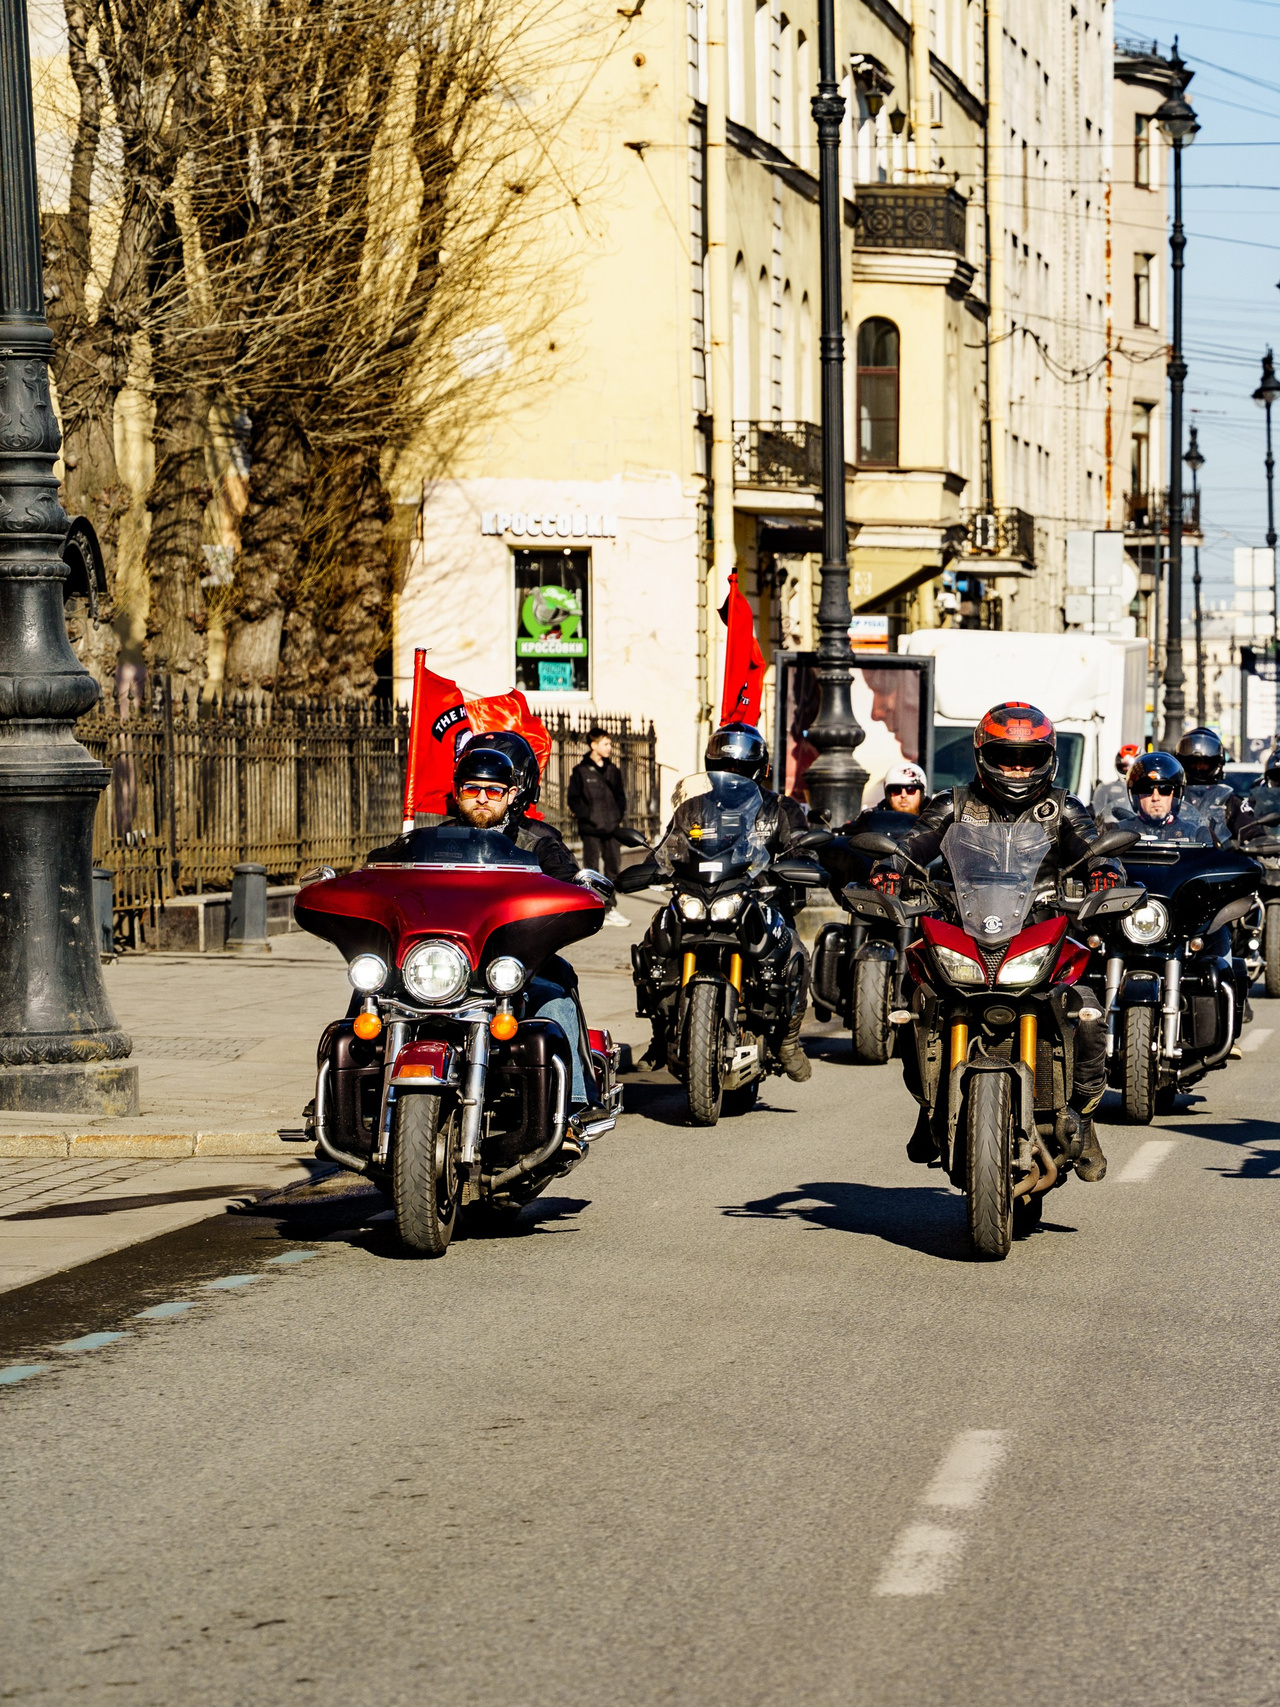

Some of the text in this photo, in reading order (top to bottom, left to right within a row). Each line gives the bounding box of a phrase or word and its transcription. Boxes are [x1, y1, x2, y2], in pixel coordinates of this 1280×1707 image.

[481, 512, 618, 538] КРОССОВКИ
[521, 642, 583, 654] КРОССОВКИ
[435, 711, 458, 733] THE
[1008, 727, 1031, 736] SHOEI
